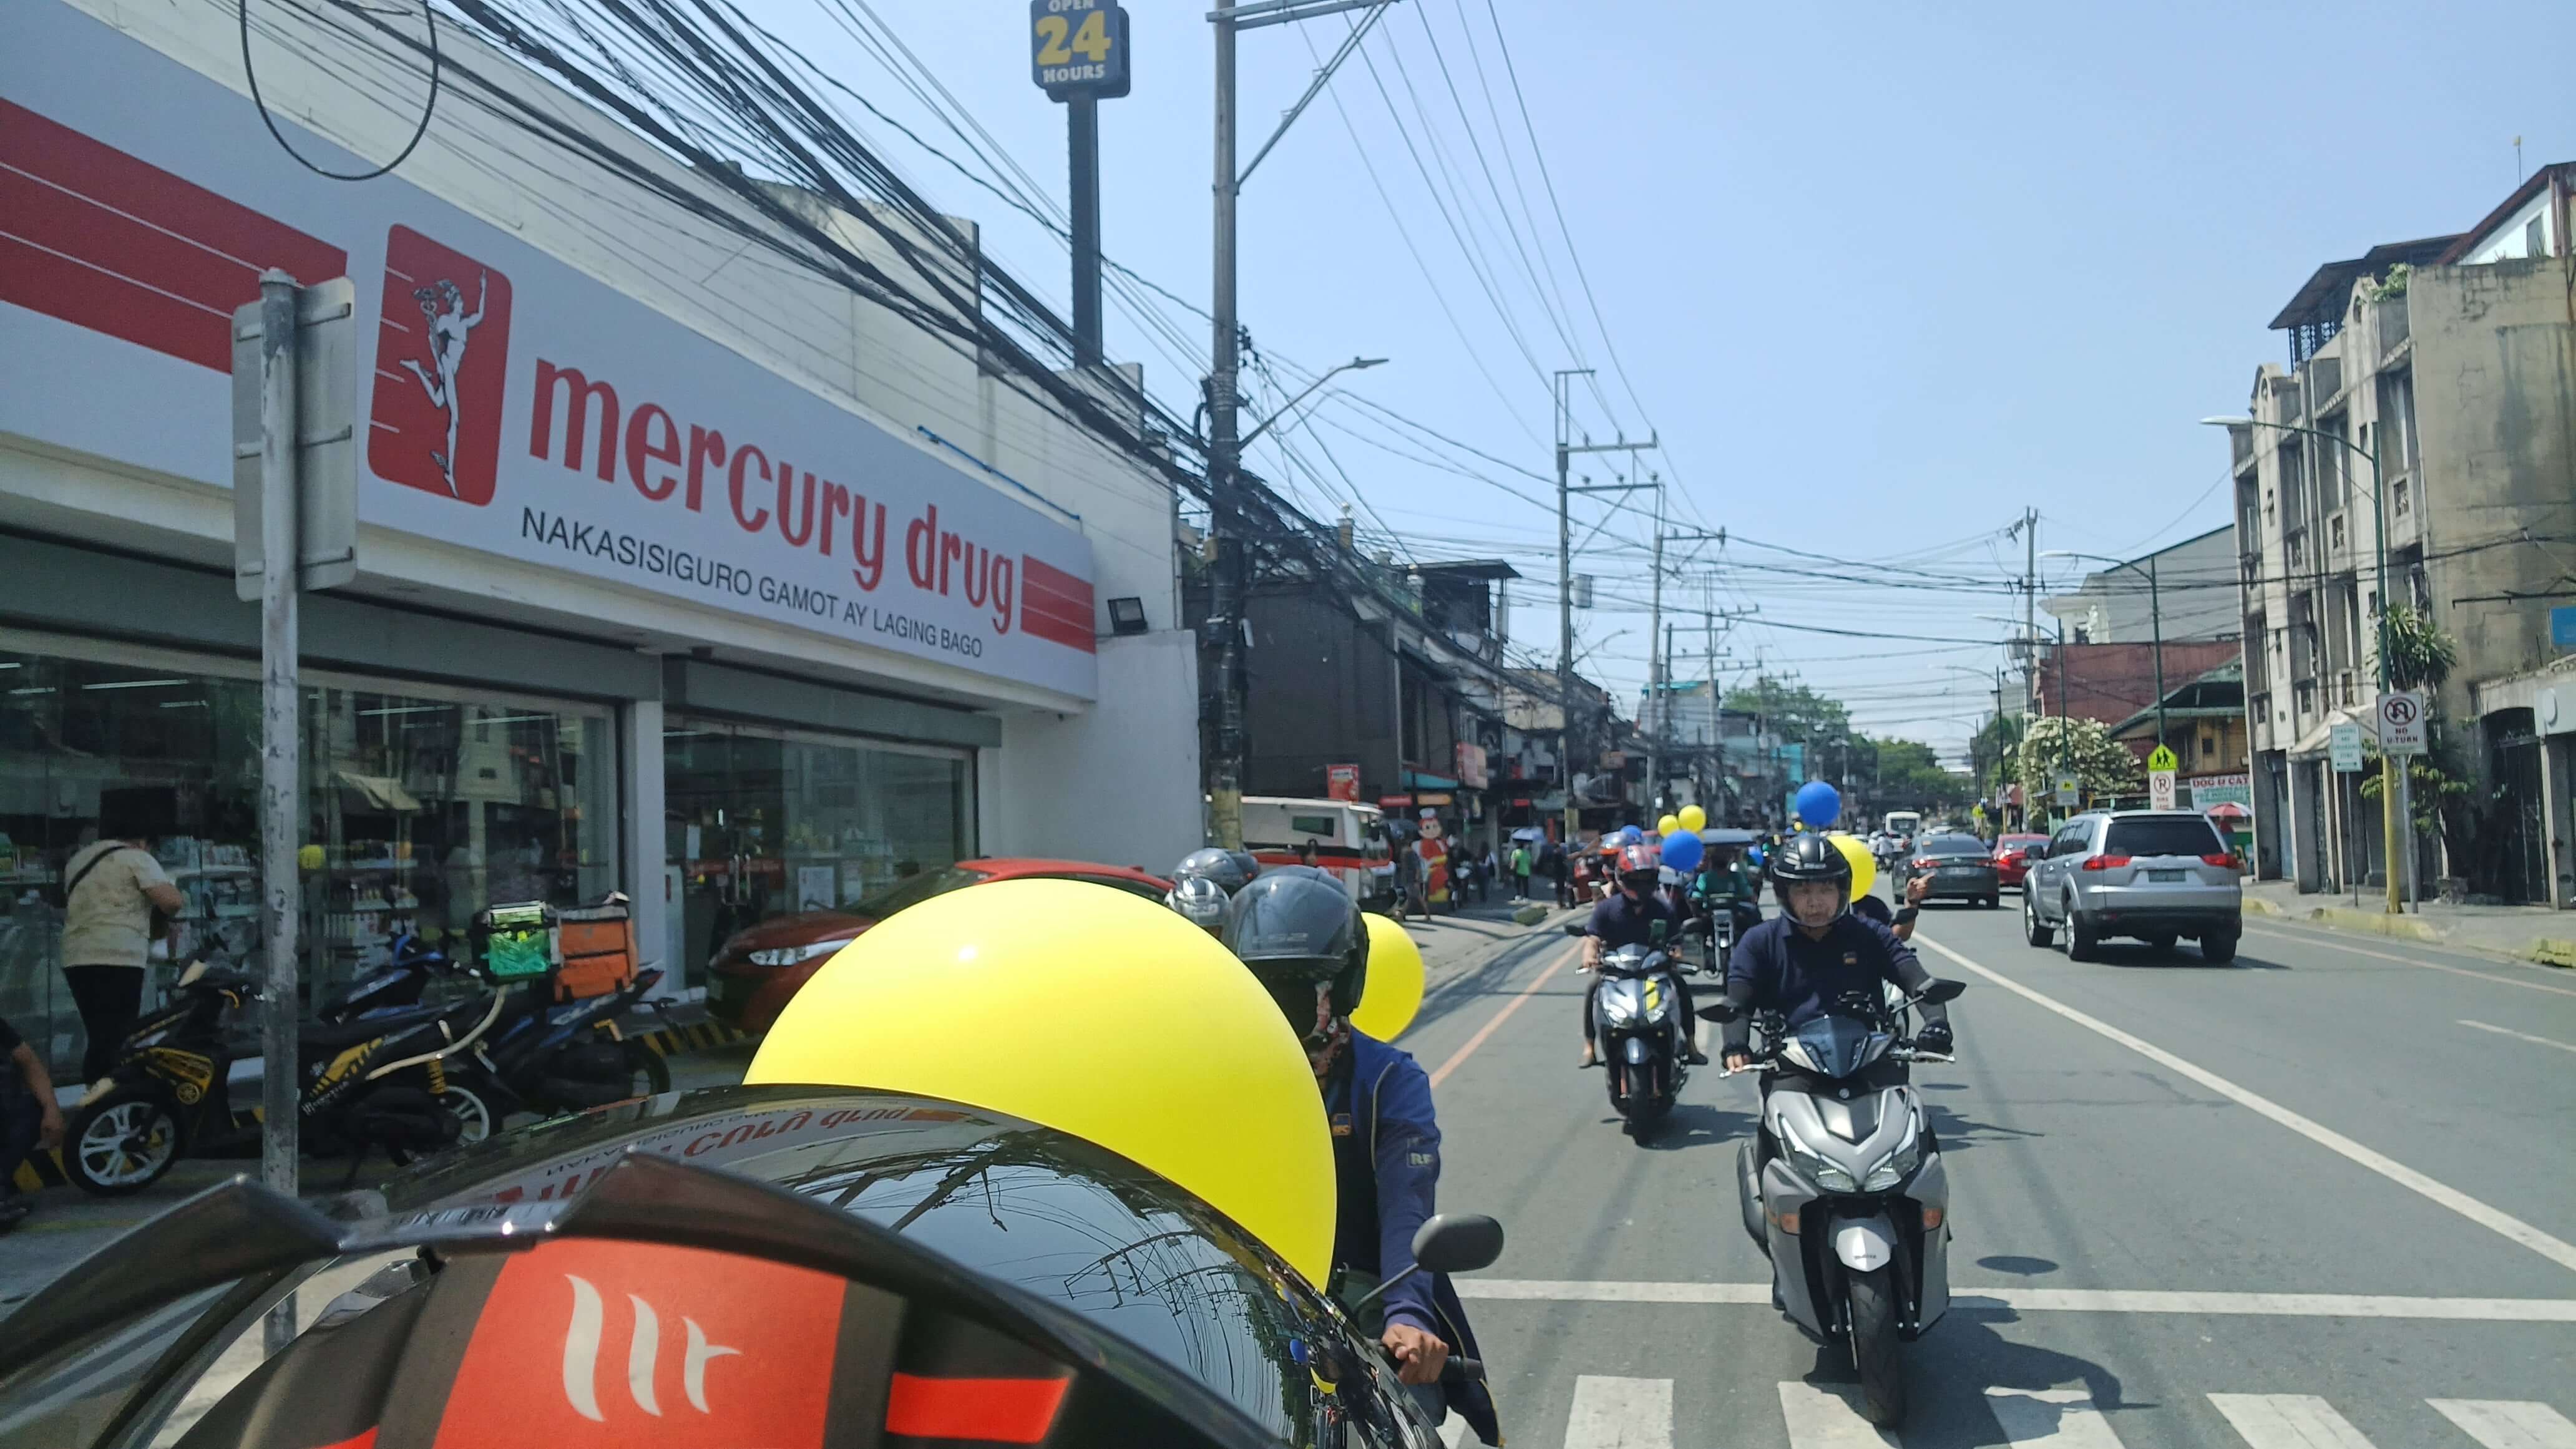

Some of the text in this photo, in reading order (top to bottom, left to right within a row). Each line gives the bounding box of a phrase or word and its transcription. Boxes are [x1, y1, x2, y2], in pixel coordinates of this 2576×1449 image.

[1048, 0, 1094, 12] OPEN
[1036, 10, 1112, 66] 24
[1043, 64, 1105, 83] HOURS
[529, 358, 1013, 634] mercury drug
[522, 505, 983, 658] NAKASISIGURO GAMOT AY LAGING BAGO
